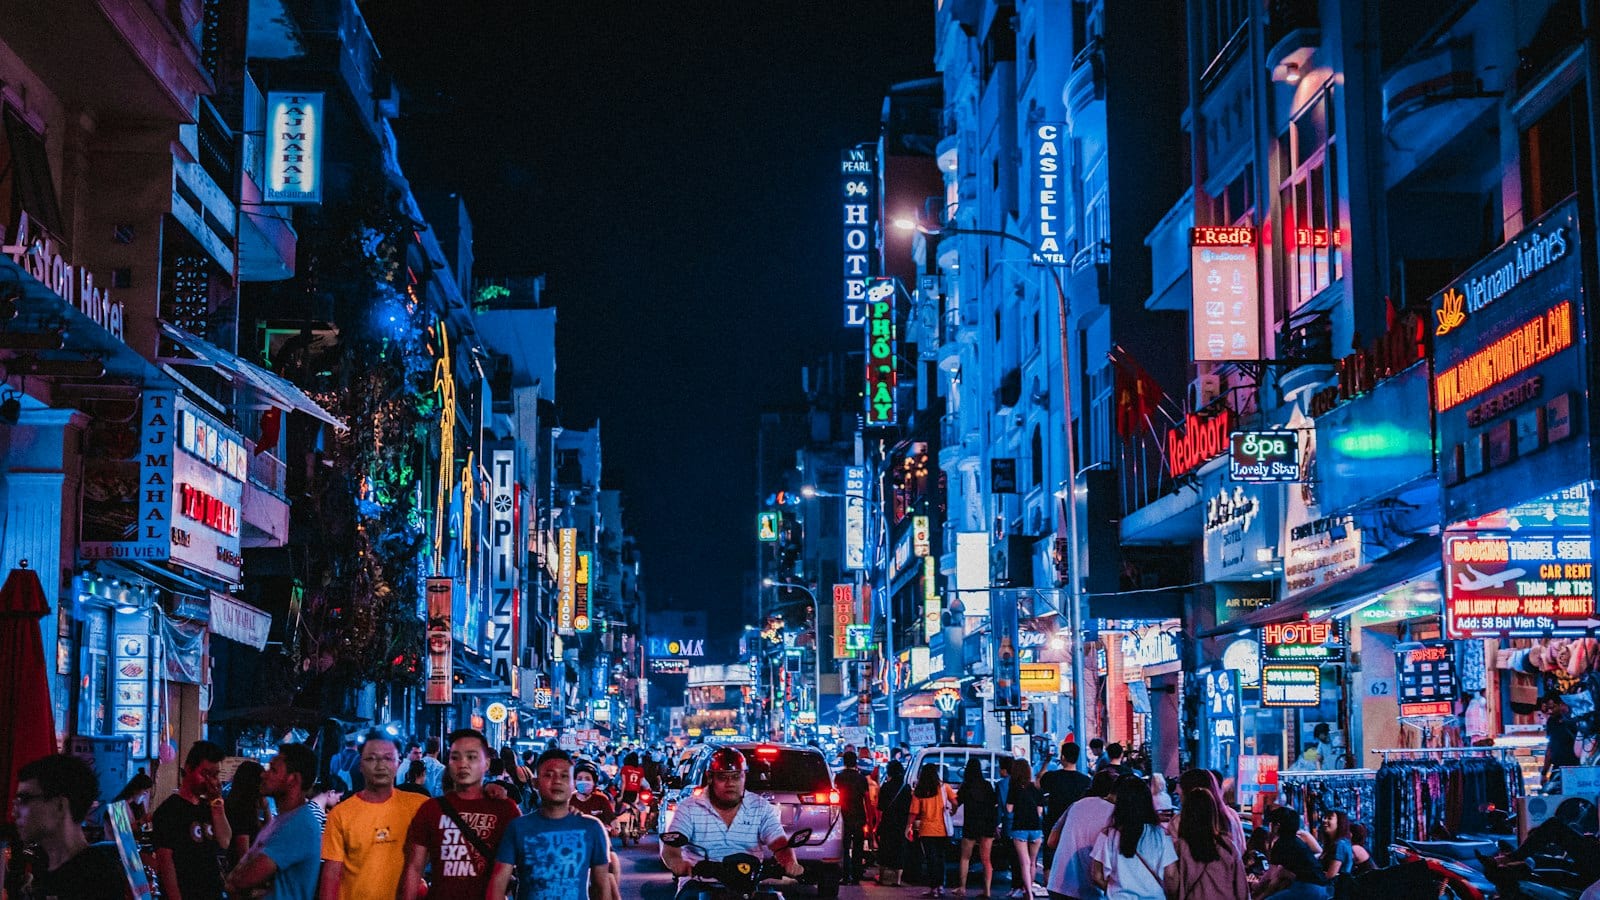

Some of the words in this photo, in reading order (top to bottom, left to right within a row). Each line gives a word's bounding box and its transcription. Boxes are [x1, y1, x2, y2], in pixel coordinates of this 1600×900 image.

[283, 96, 306, 126] TAJ
[282, 132, 306, 184] MAHAL
[850, 150, 864, 161] VN
[843, 162, 870, 172] PEARL
[268, 188, 315, 198] Restaurant
[846, 182, 868, 197] 94
[1038, 125, 1059, 251] CASTELLA
[846, 205, 866, 325] HOTEL
[1464, 260, 1515, 314] Vietnam
[1515, 227, 1566, 283] Airlines
[80, 266, 125, 343] Hotel
[1436, 300, 1571, 413] WWW.BOOKINGYOURTRAVEL.COM
[147, 395, 168, 444] TAJ
[1169, 410, 1229, 478] RedDoorz
[1242, 434, 1287, 461] Spa
[1234, 462, 1269, 477] Lovely
[1272, 463, 1297, 474] Star
[145, 454, 168, 538] MAHAL
[1454, 541, 1509, 562] BOOKING
[1540, 564, 1561, 579] CAR
[1564, 564, 1592, 579] RENT
[834, 586, 852, 602] 96
[1517, 581, 1547, 596] TRAIN
[561, 585, 571, 628] SAIGON
[1225, 598, 1240, 607] AIR
[1497, 599, 1519, 615] GROUP
[1524, 599, 1554, 614] PACKAGE
[1559, 599, 1587, 614] PRIVATE
[837, 604, 849, 657] HOTEL
[1457, 617, 1479, 629] Add:
[1482, 617, 1494, 629] 58
[1496, 616, 1512, 629] Bui
[1514, 616, 1535, 629] Vien
[1267, 671, 1284, 681] SPA
[1371, 682, 1388, 695] 62
